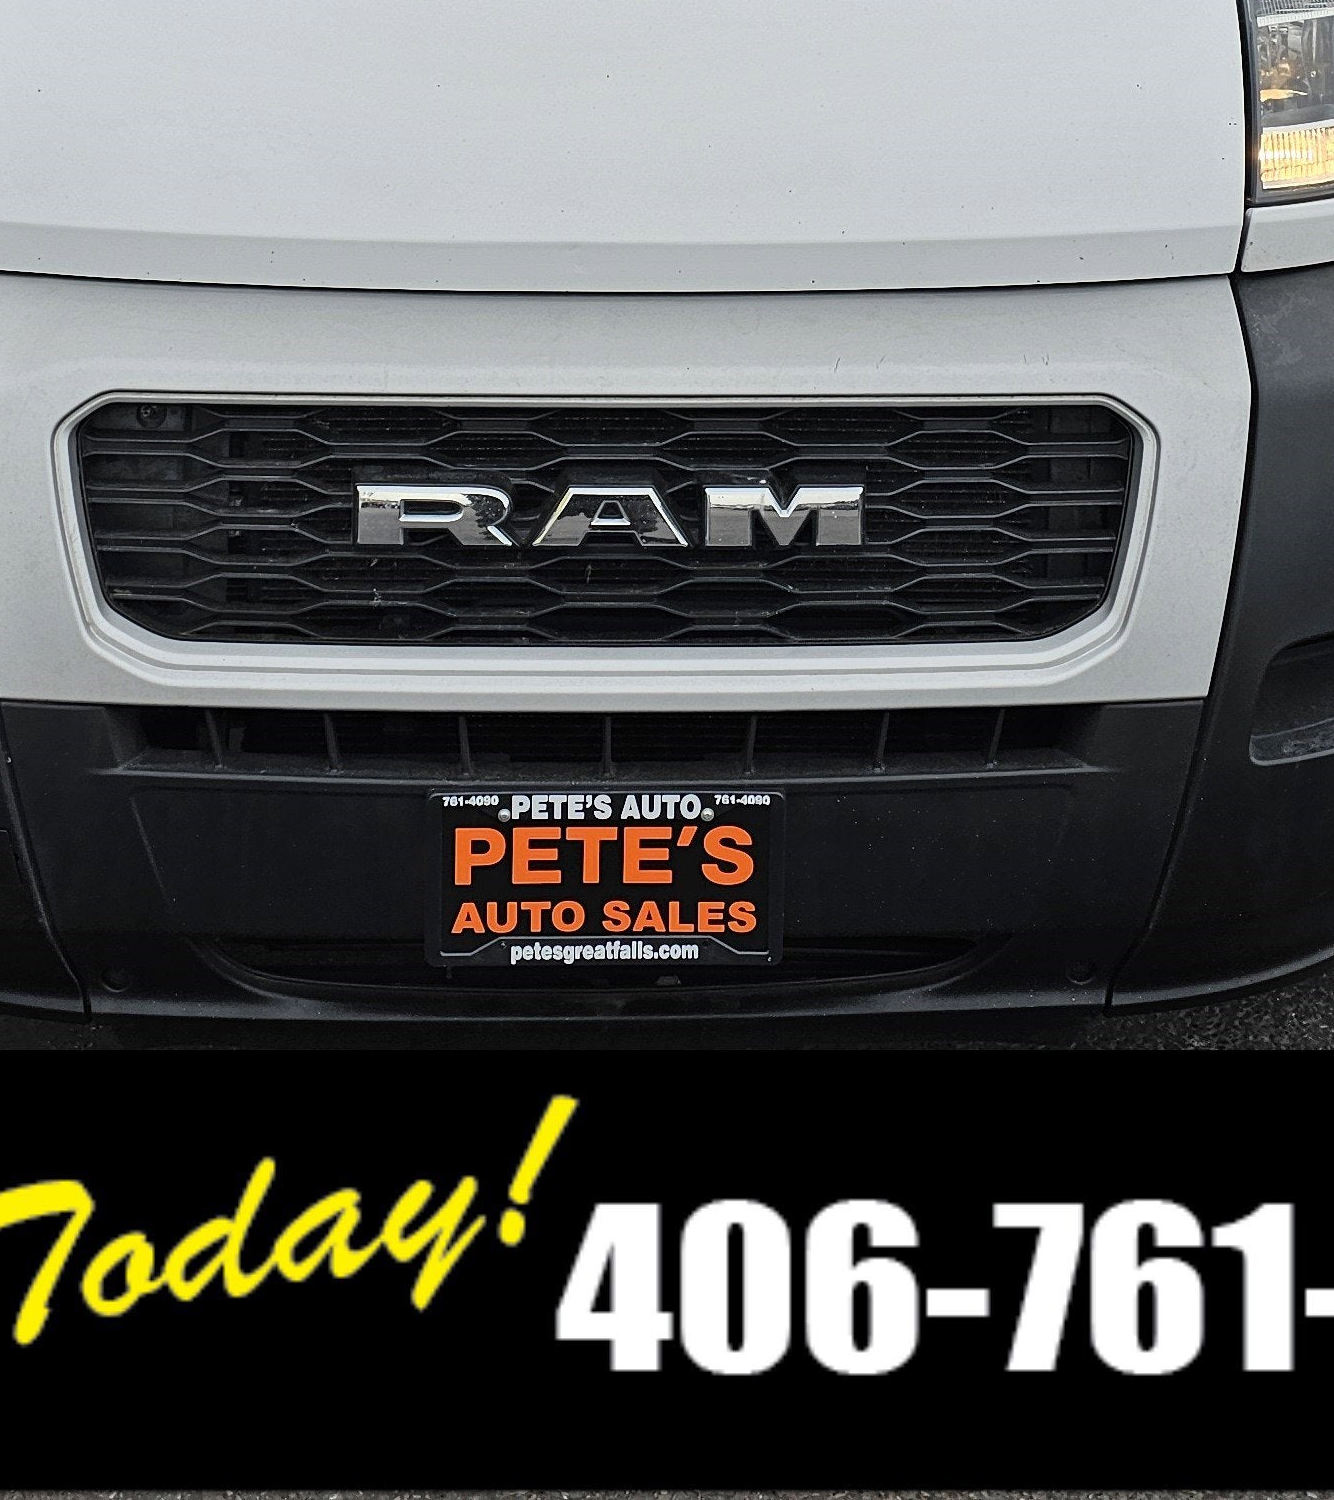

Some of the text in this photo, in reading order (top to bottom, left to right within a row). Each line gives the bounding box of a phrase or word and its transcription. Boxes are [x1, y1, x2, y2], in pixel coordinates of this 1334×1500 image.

[355, 484, 865, 547] RAM
[442, 794, 771, 820] 761-4090 PETE'S AUTO 761-4090
[453, 825, 755, 886] PETE'S
[451, 900, 757, 934] AUTO SALES
[509, 940, 700, 965] petesgreatfalls.com
